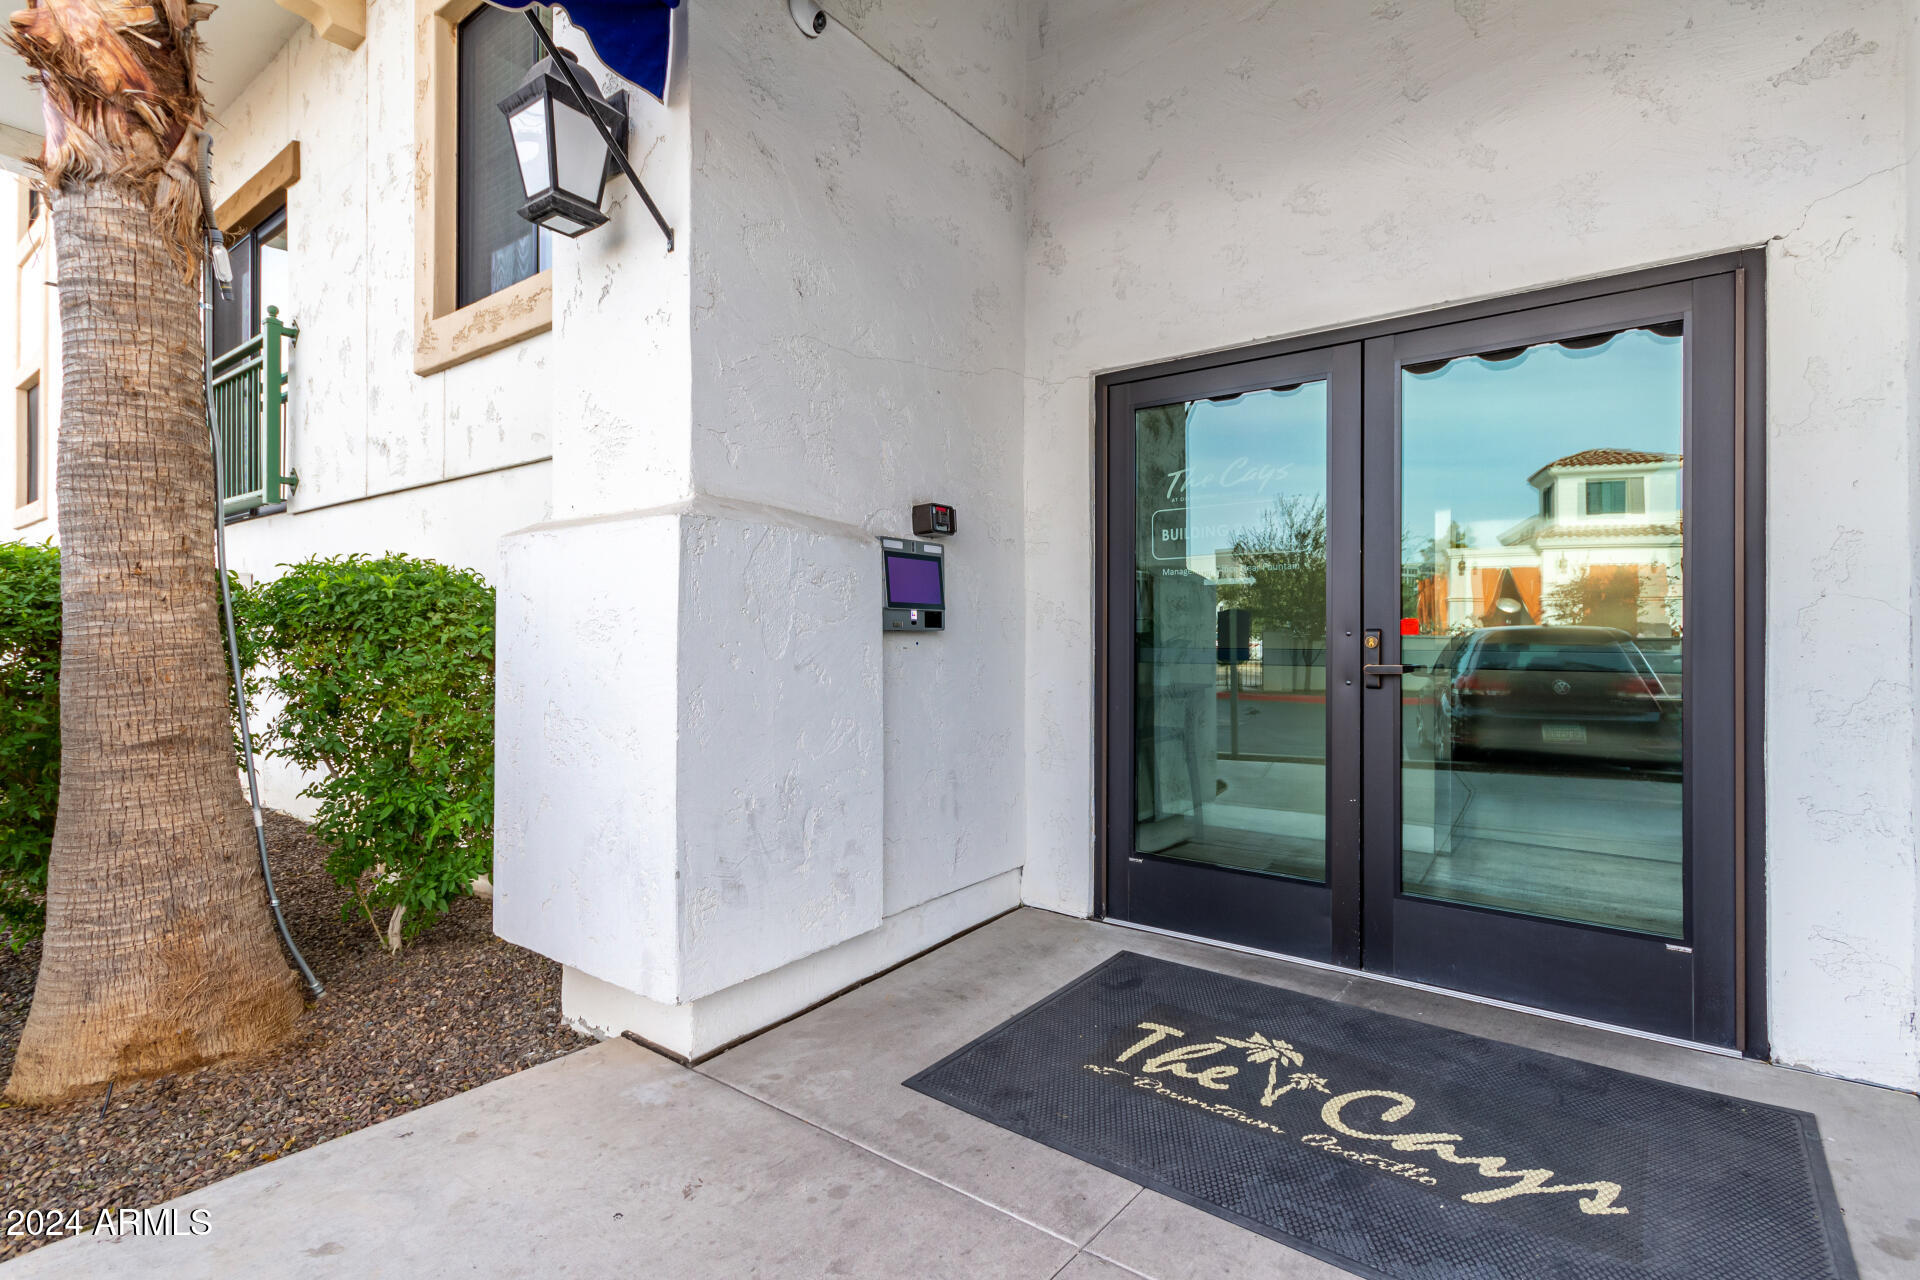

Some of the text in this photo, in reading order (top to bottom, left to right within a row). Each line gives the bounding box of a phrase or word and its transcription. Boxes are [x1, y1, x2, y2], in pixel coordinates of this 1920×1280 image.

[1166, 456, 1295, 499] The Cays
[1162, 566, 1216, 577] Manage
[1115, 1021, 1242, 1090] The
